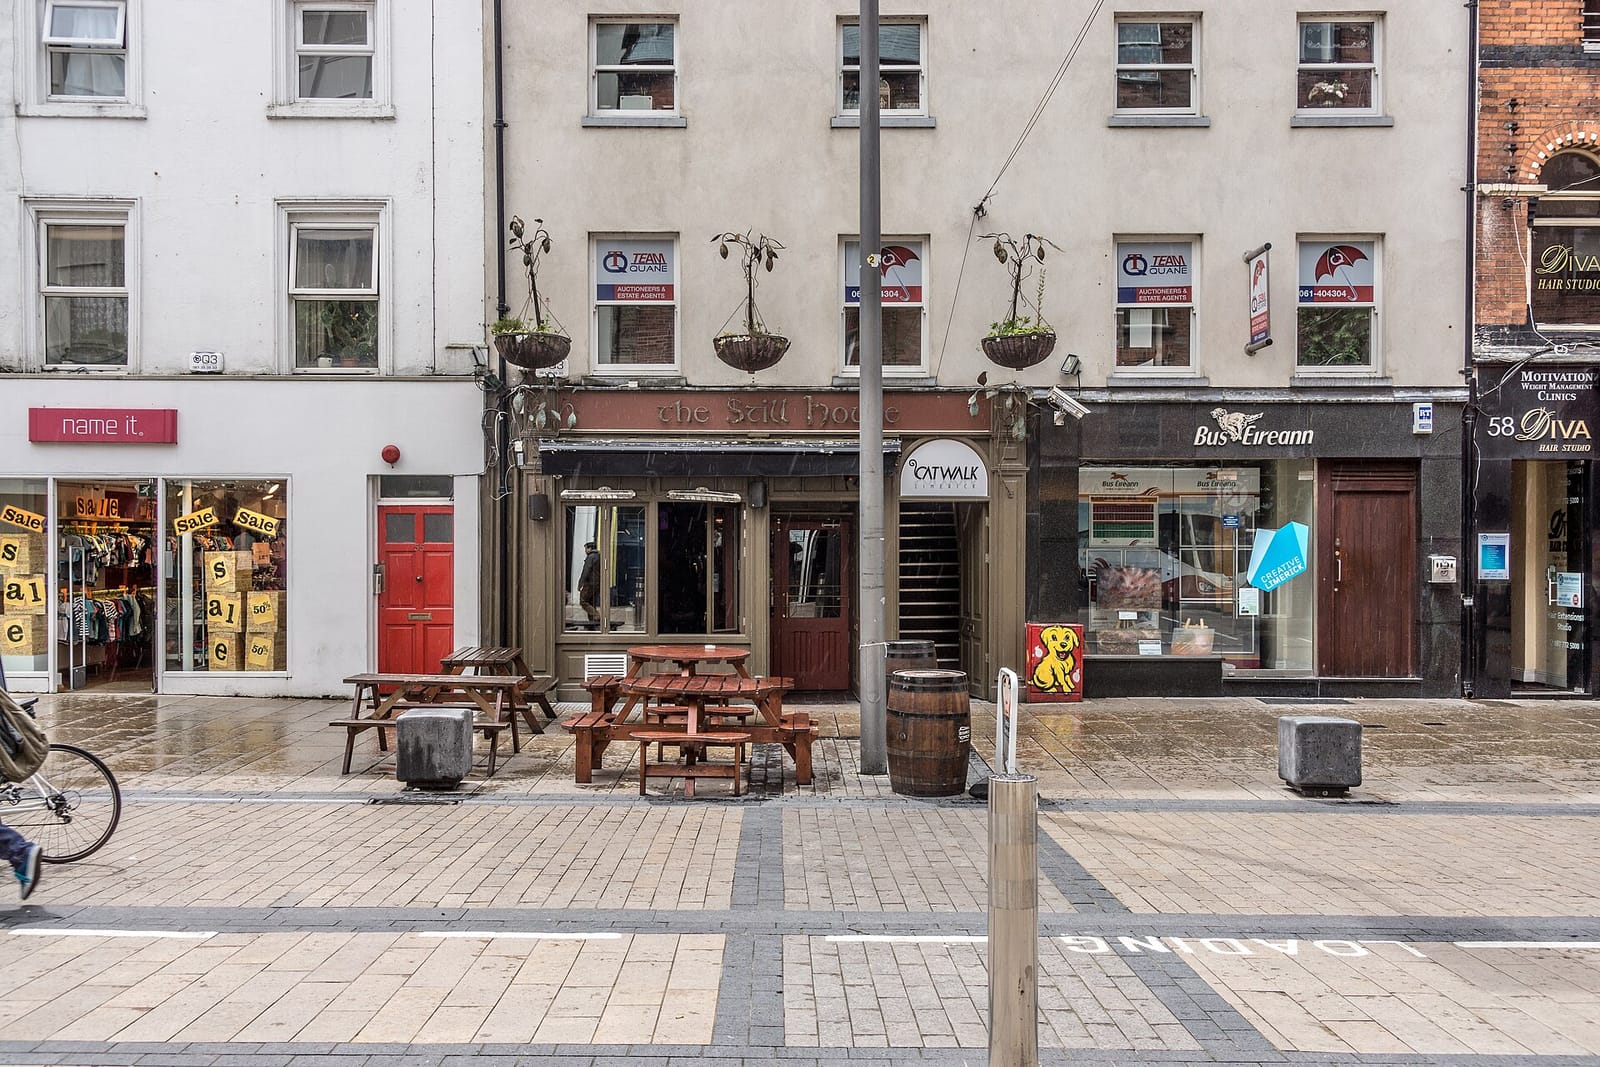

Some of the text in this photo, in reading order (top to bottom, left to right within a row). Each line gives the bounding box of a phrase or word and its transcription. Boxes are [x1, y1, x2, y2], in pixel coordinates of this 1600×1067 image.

[633, 253, 666, 264] TEAM
[1152, 255, 1186, 266] TEAM
[1149, 267, 1187, 275] QUANE
[1537, 279, 1563, 290] HAIR
[1299, 290, 1347, 298] 061-404304
[1521, 371, 1593, 382] MOTIVATION
[1537, 391, 1577, 401] CLINICS
[657, 400, 710, 423] the
[725, 397, 789, 424] Still
[63, 418, 118, 435] name
[1487, 416, 1515, 437] 58
[1193, 425, 1227, 446] Bus
[1539, 444, 1591, 452] HAIR STUDIO
[909, 459, 979, 480] CATWALK
[1261, 556, 1301, 583] CREATIVE
[1264, 563, 1304, 590] LIMERICK
[1058, 934, 1428, 957] LOADING
